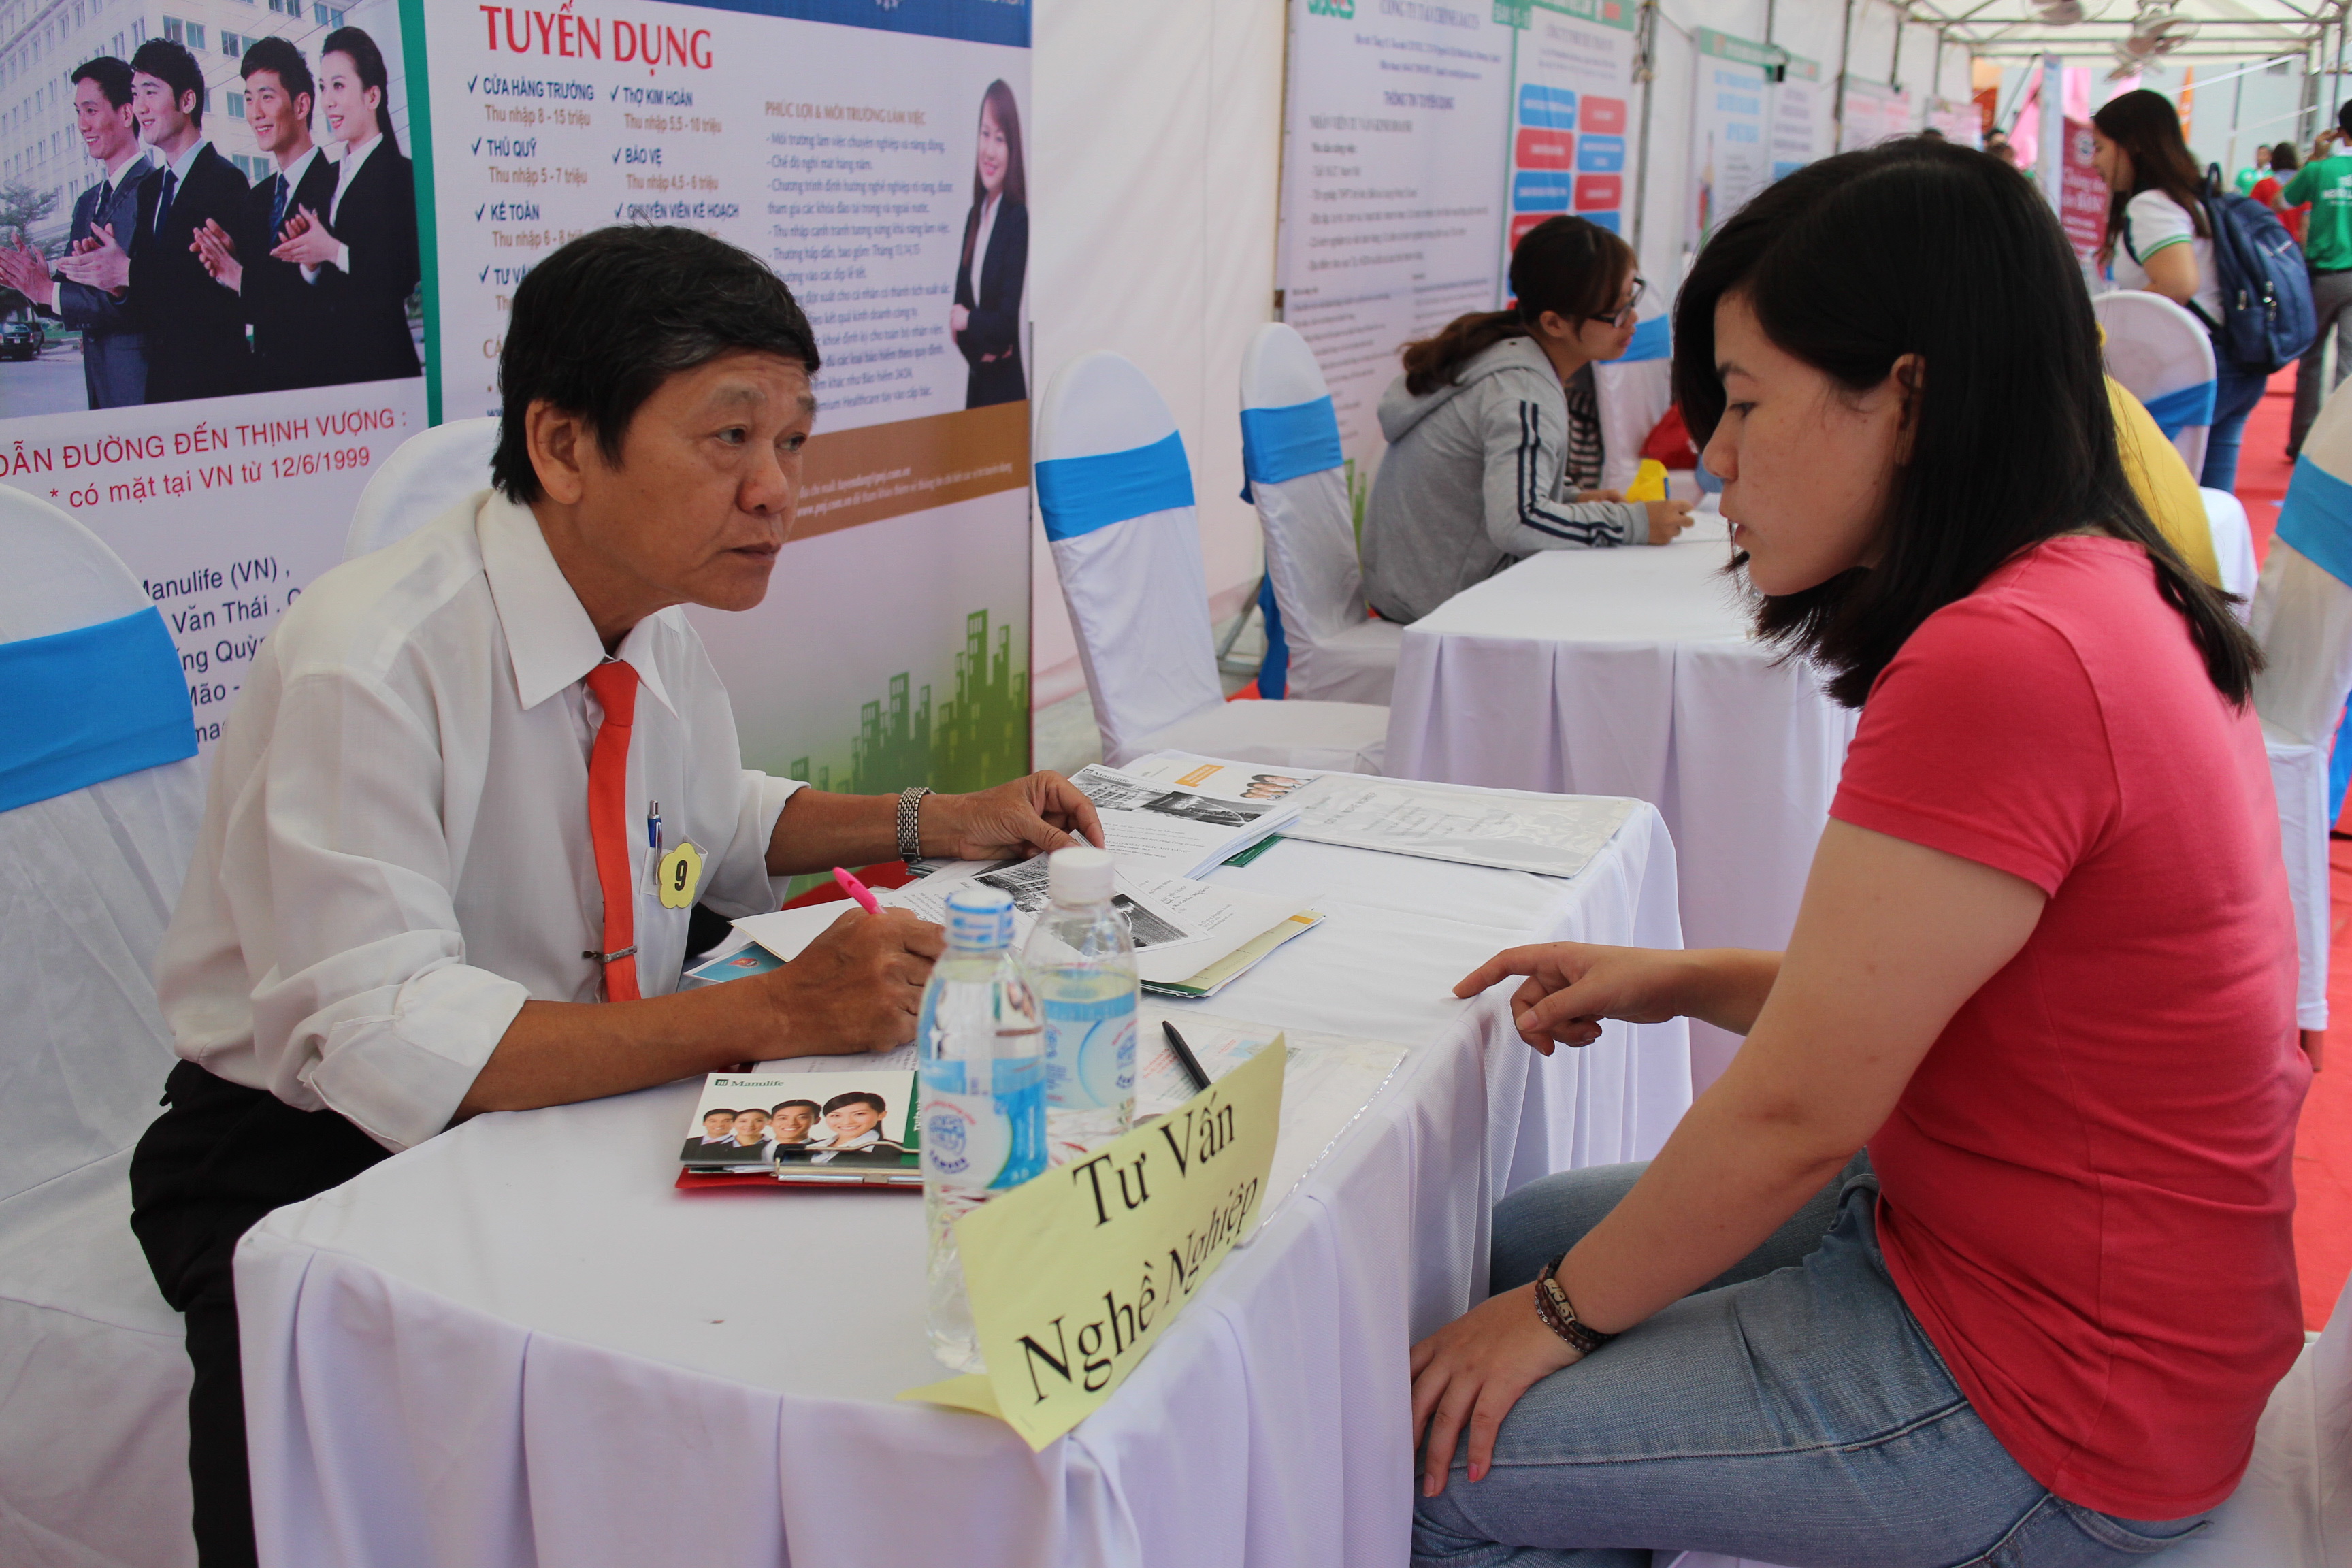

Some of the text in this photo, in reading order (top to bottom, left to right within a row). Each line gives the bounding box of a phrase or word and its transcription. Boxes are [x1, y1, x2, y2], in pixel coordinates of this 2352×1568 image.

[480, 0, 713, 76] TUYỂN DỤNG
[483, 74, 510, 95] CỬA
[512, 76, 544, 97] HÀNG
[647, 88, 664, 105] KIM
[485, 104, 506, 122] Thu
[509, 105, 535, 127] nhập
[554, 108, 566, 125] 15
[568, 109, 591, 129] triệu
[624, 112, 642, 129] Thu
[644, 114, 668, 133] nhập
[702, 117, 722, 135] triệu
[487, 135, 537, 158] THỦ QUỸ
[625, 144, 663, 167] BẢO VỆ
[489, 166, 510, 183] Thu
[512, 167, 538, 187] nhập
[556, 168, 562, 184] 7
[564, 168, 587, 187] triệu
[626, 173, 644, 189] Thu
[647, 174, 669, 193] nhập
[699, 175, 719, 193] triệu
[491, 200, 506, 220] KẾ
[492, 230, 513, 248] Thu
[516, 230, 542, 250] nhập
[494, 268, 510, 285] TƯ
[63, 434, 165, 470] ĐƯỜNG
[174, 421, 229, 455] ĐẾN
[236, 416, 310, 448] THỊNH
[316, 408, 396, 438] VƯỢNG
[69, 446, 371, 508] có mặt tại VN từ 12/6/1999
[231, 556, 278, 591] (VN)
[172, 604, 216, 634] Văn
[222, 595, 269, 623] Thái
[216, 634, 266, 663] Quỳ
[674, 860, 689, 892] 9
[731, 1079, 784, 1088] Manulife
[1073, 1090, 1235, 1229] Tư Vấn
[1015, 1173, 1259, 1407] Nghề Nghiệp
